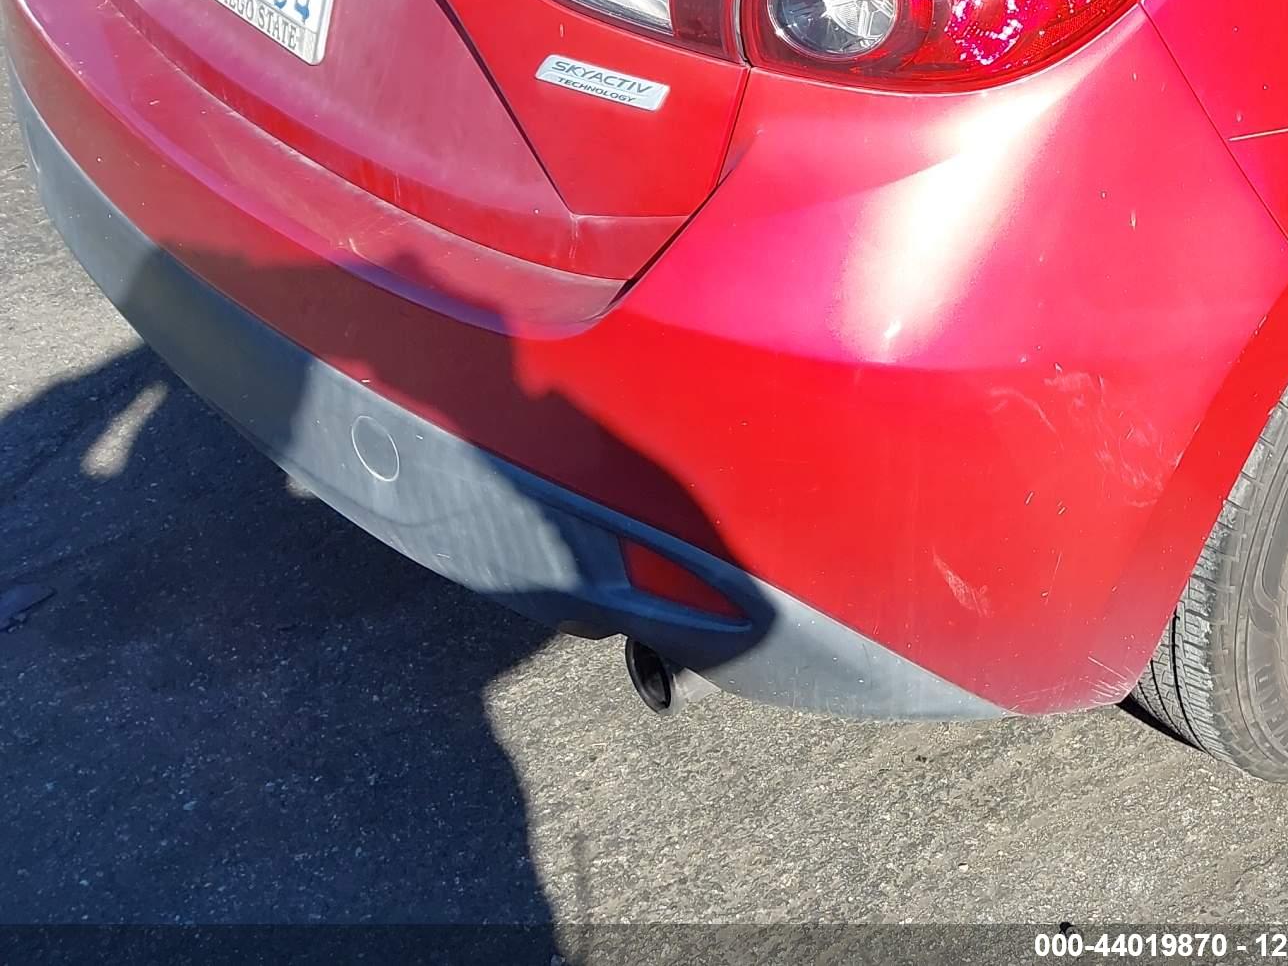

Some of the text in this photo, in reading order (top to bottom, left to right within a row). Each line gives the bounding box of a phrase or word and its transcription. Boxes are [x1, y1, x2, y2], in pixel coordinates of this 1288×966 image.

[257, 5, 297, 50] STATE
[552, 60, 653, 94] SKYACTIV
[558, 77, 636, 103] TECHNOLOGY
